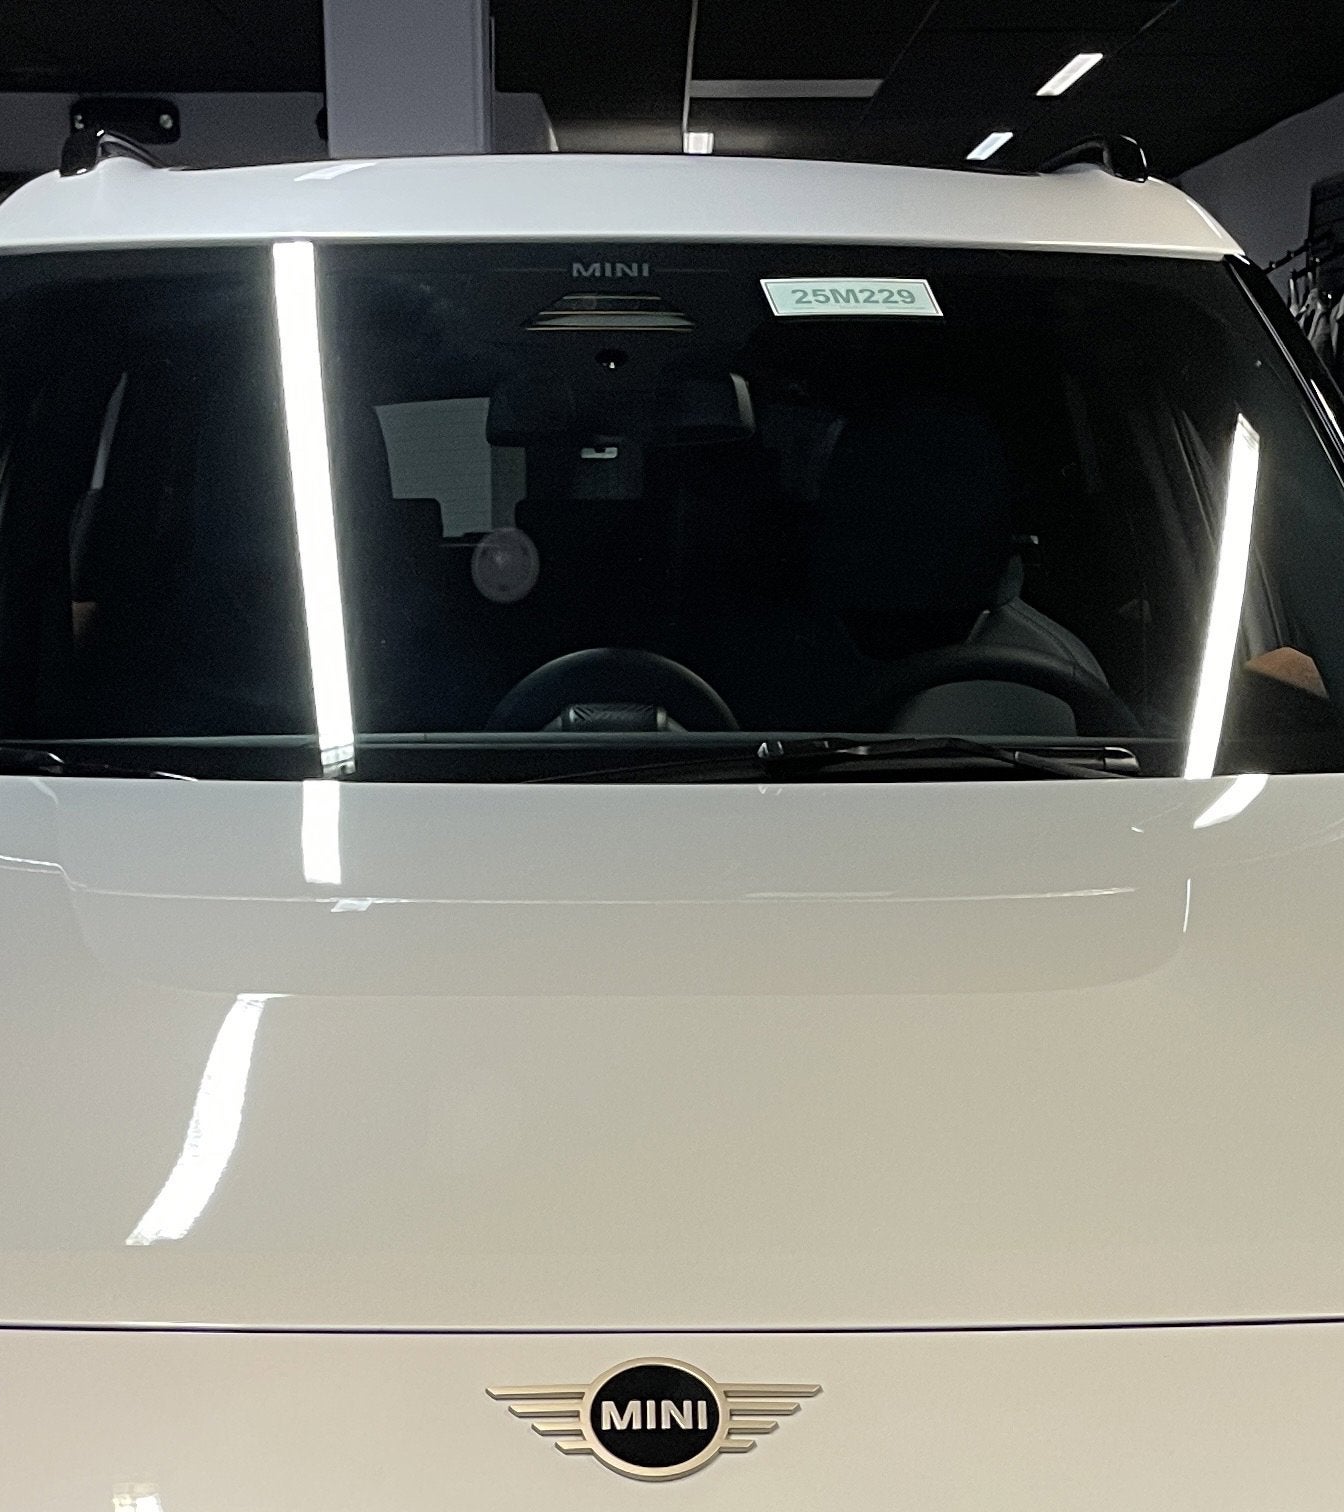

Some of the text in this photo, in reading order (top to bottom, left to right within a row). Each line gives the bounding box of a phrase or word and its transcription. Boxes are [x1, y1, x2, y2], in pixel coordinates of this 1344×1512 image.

[572, 262, 649, 277] MINI
[791, 288, 916, 304] 25M229
[601, 1400, 708, 1430] MINI
